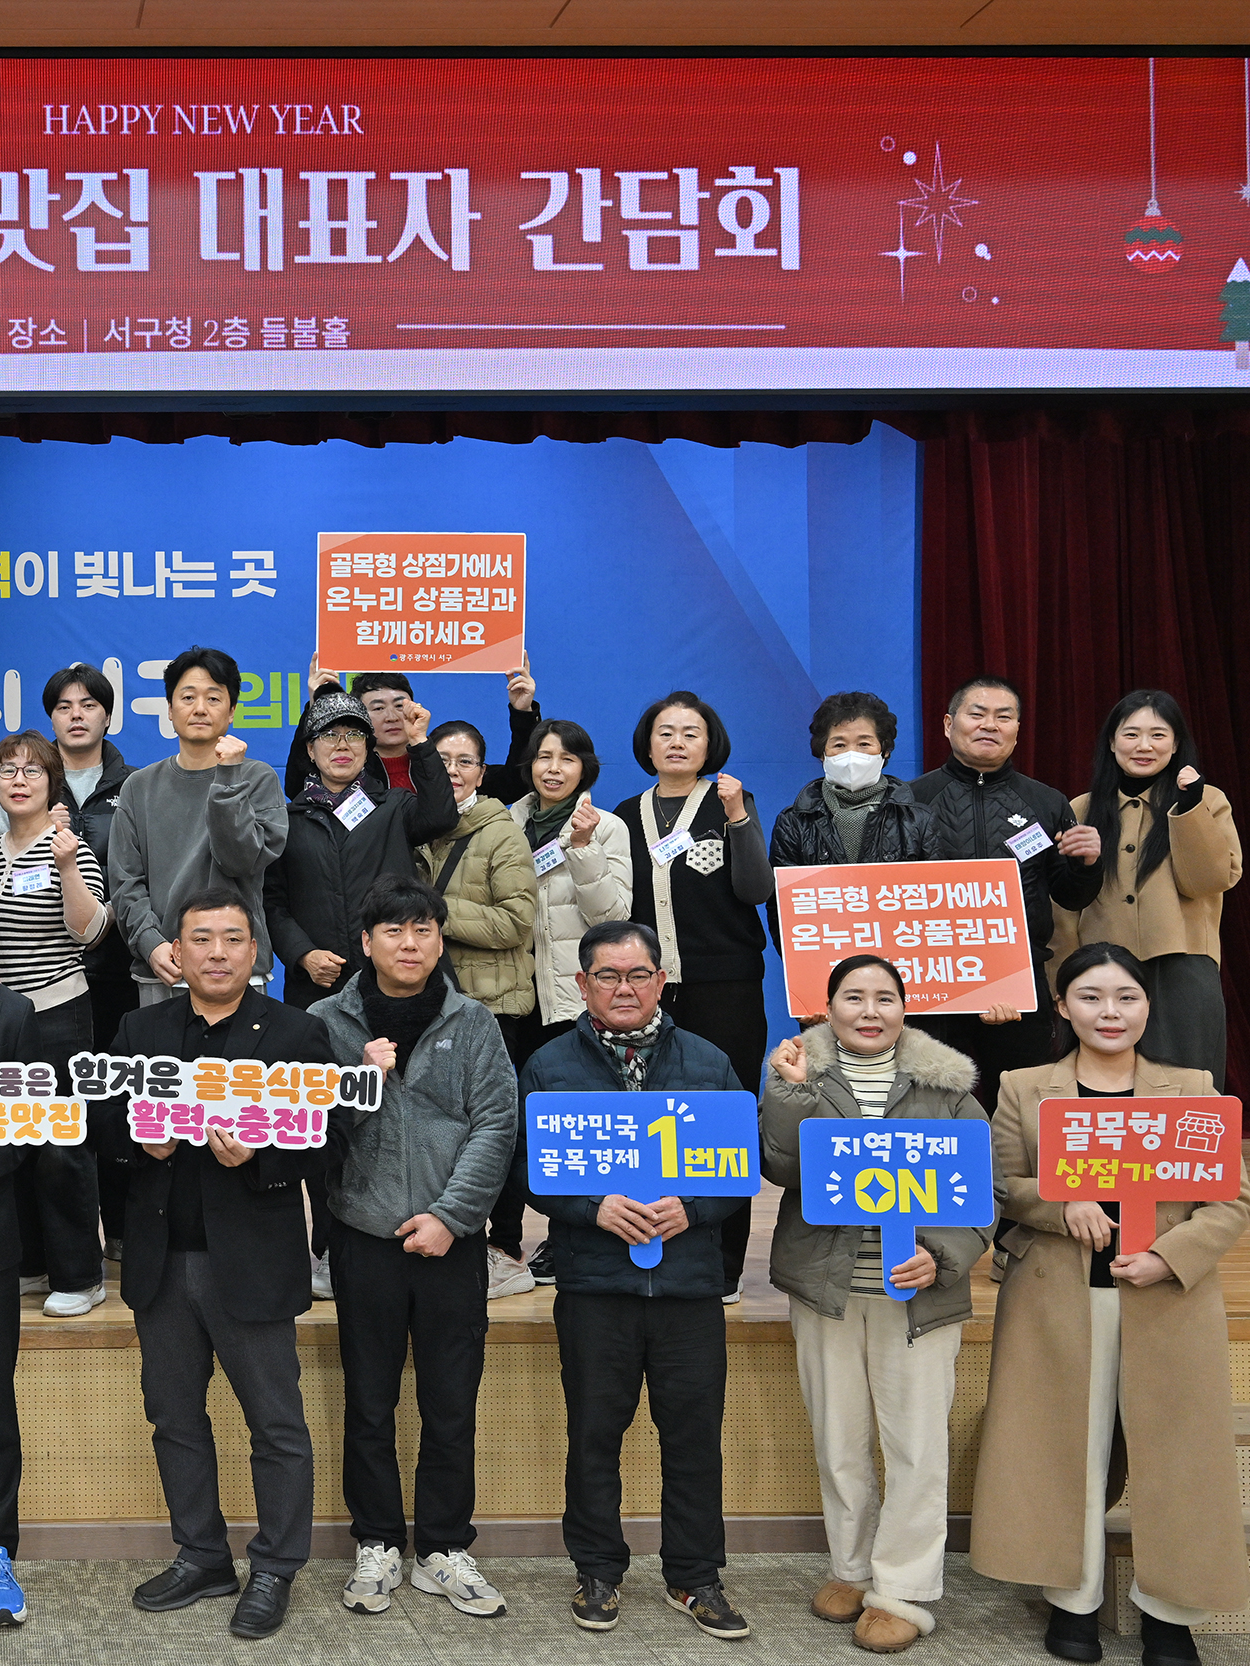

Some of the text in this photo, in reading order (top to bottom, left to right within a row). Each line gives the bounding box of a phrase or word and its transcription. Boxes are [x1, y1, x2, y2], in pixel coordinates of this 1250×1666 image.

[42, 104, 364, 135] HAPPY NEW YEAR
[194, 165, 481, 272] 대표자
[518, 165, 801, 272] 간담회
[6, 316, 350, 350] 장소 서구청 2층 들불홀
[74, 551, 217, 598] 빛나는
[230, 551, 278, 598] 곳
[329, 551, 512, 578] 골목형 상점가에서
[326, 586, 517, 613] 온누리 상품권과
[355, 620, 486, 647] 함께하세요
[399, 653, 453, 662] 광주광역시 서구
[791, 881, 1008, 915] 골목형 상점가에서
[791, 917, 1018, 951] 온누리 상품권과
[932, 993, 949, 1001] 서구
[74, 1056, 379, 1107] 힘겨운 골목식당에
[536, 1113, 639, 1141] 대한민국
[1062, 1111, 1167, 1151] 골목형
[647, 1115, 749, 1178] 1번지
[831, 1132, 958, 1164] 지역경제
[1055, 1158, 1223, 1188] 상점가에서
[854, 1168, 938, 1213] ON
